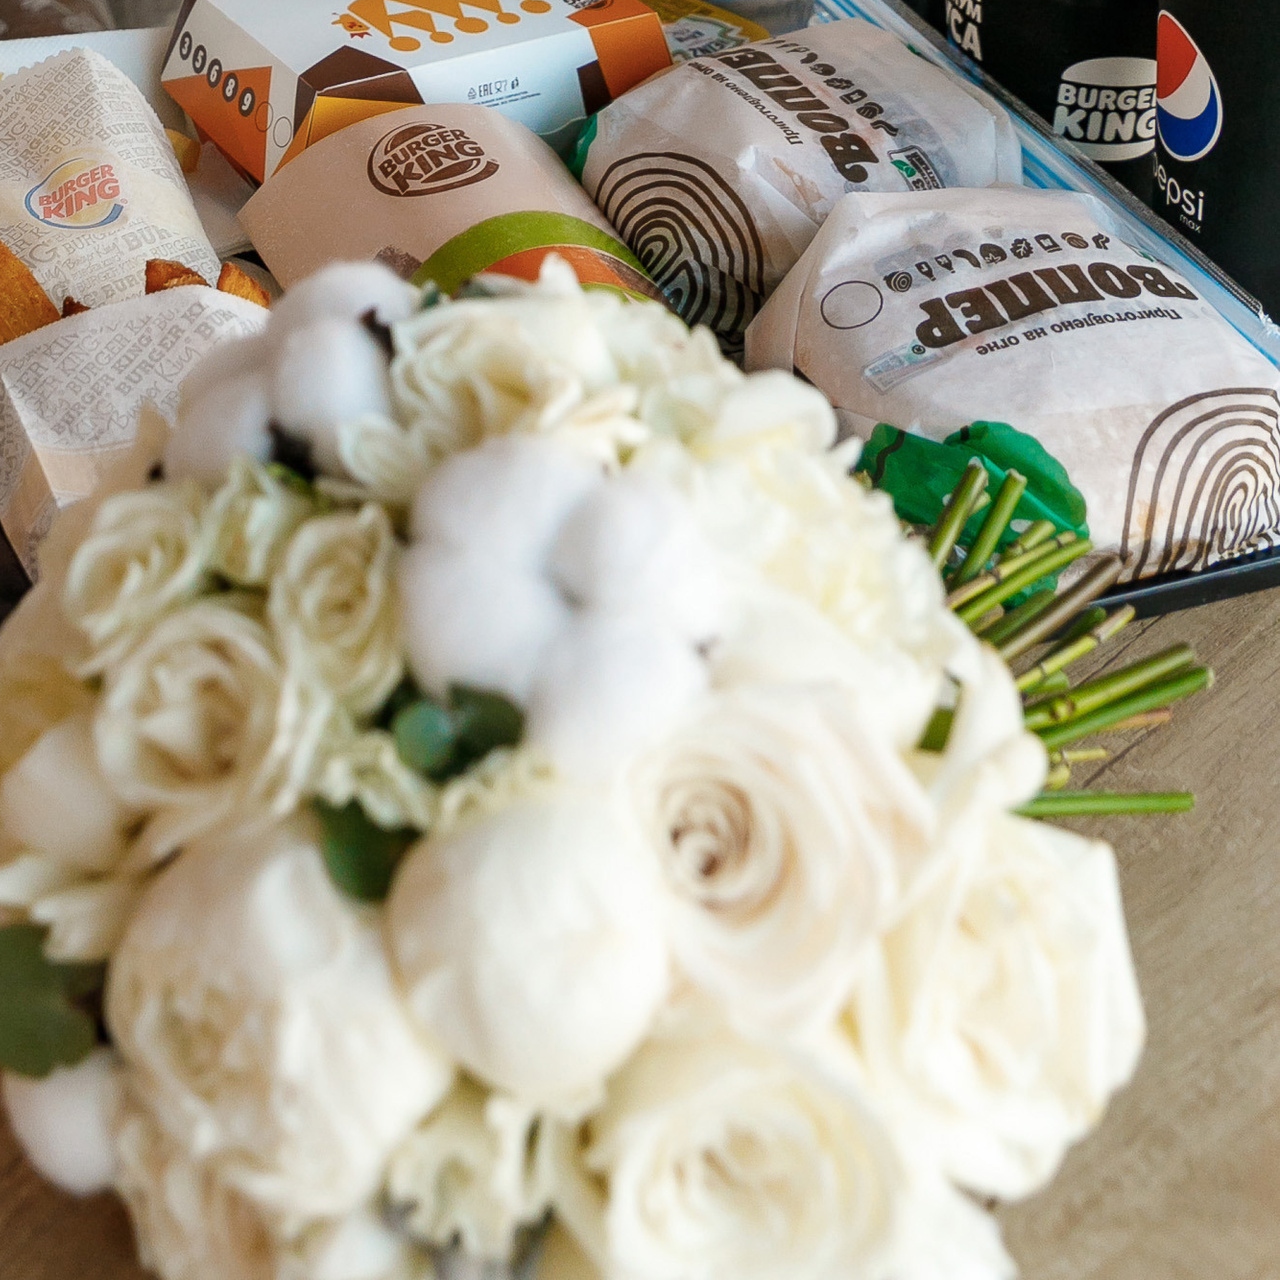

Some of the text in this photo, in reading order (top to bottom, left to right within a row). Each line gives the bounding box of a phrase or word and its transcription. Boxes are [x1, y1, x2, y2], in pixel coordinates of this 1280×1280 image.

[25, 55, 85, 113] BURGER
[58, 81, 98, 118] KING
[711, 72, 728, 85] на
[22, 96, 66, 142] BURGER
[65, 70, 93, 97] KING
[49, 103, 106, 155] BURGER
[51, 96, 97, 139] BURGER
[711, 47, 879, 183] ВОППЕ
[726, 82, 803, 146] Приготовлено
[1053, 105, 1156, 142] KING
[378, 129, 470, 179] BURGER
[392, 140, 485, 193] KING
[39, 164, 115, 206] BURGER
[43, 178, 121, 219] KING
[1154, 152, 1205, 222] epsi
[1179, 214, 1201, 233] max
[915, 262, 1200, 349] ВОППЕР
[55, 331, 101, 376] KING
[110, 331, 153, 374] KING
[975, 308, 1183, 355] Приготовлено на огне
[65, 332, 130, 395] BURGER
[115, 323, 185, 396] BURGER
